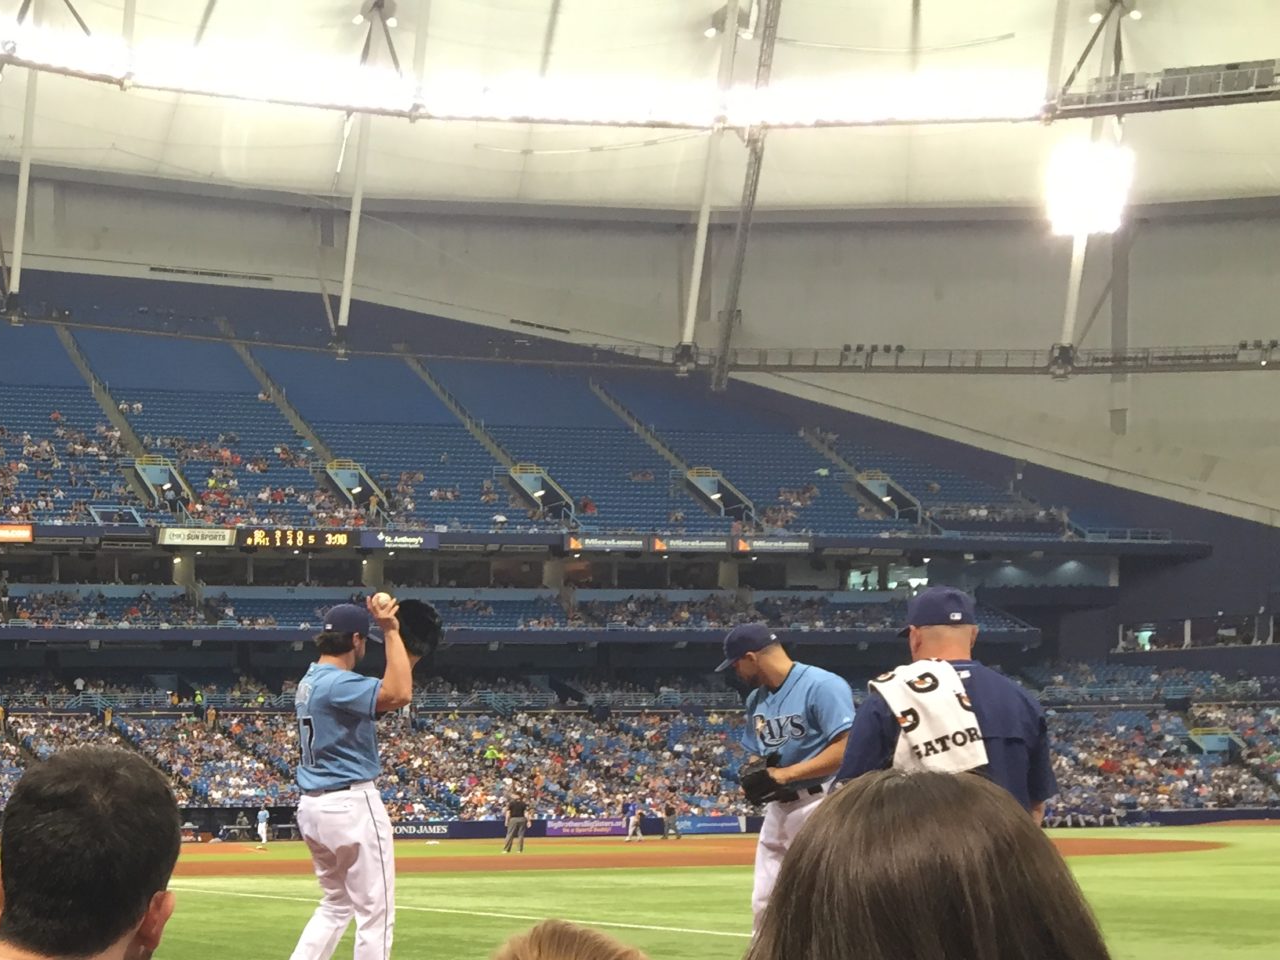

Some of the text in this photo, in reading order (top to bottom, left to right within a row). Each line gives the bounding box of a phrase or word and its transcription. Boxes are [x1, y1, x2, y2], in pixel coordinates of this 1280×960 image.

[186, 533, 200, 541] SUN
[201, 533, 226, 541] SPORTS
[253, 537, 270, 546] PHI
[325, 533, 348, 545] 3:00
[393, 536, 424, 545] Anthony's
[752, 712, 807, 750] RAYS
[416, 825, 449, 835] JAMES
